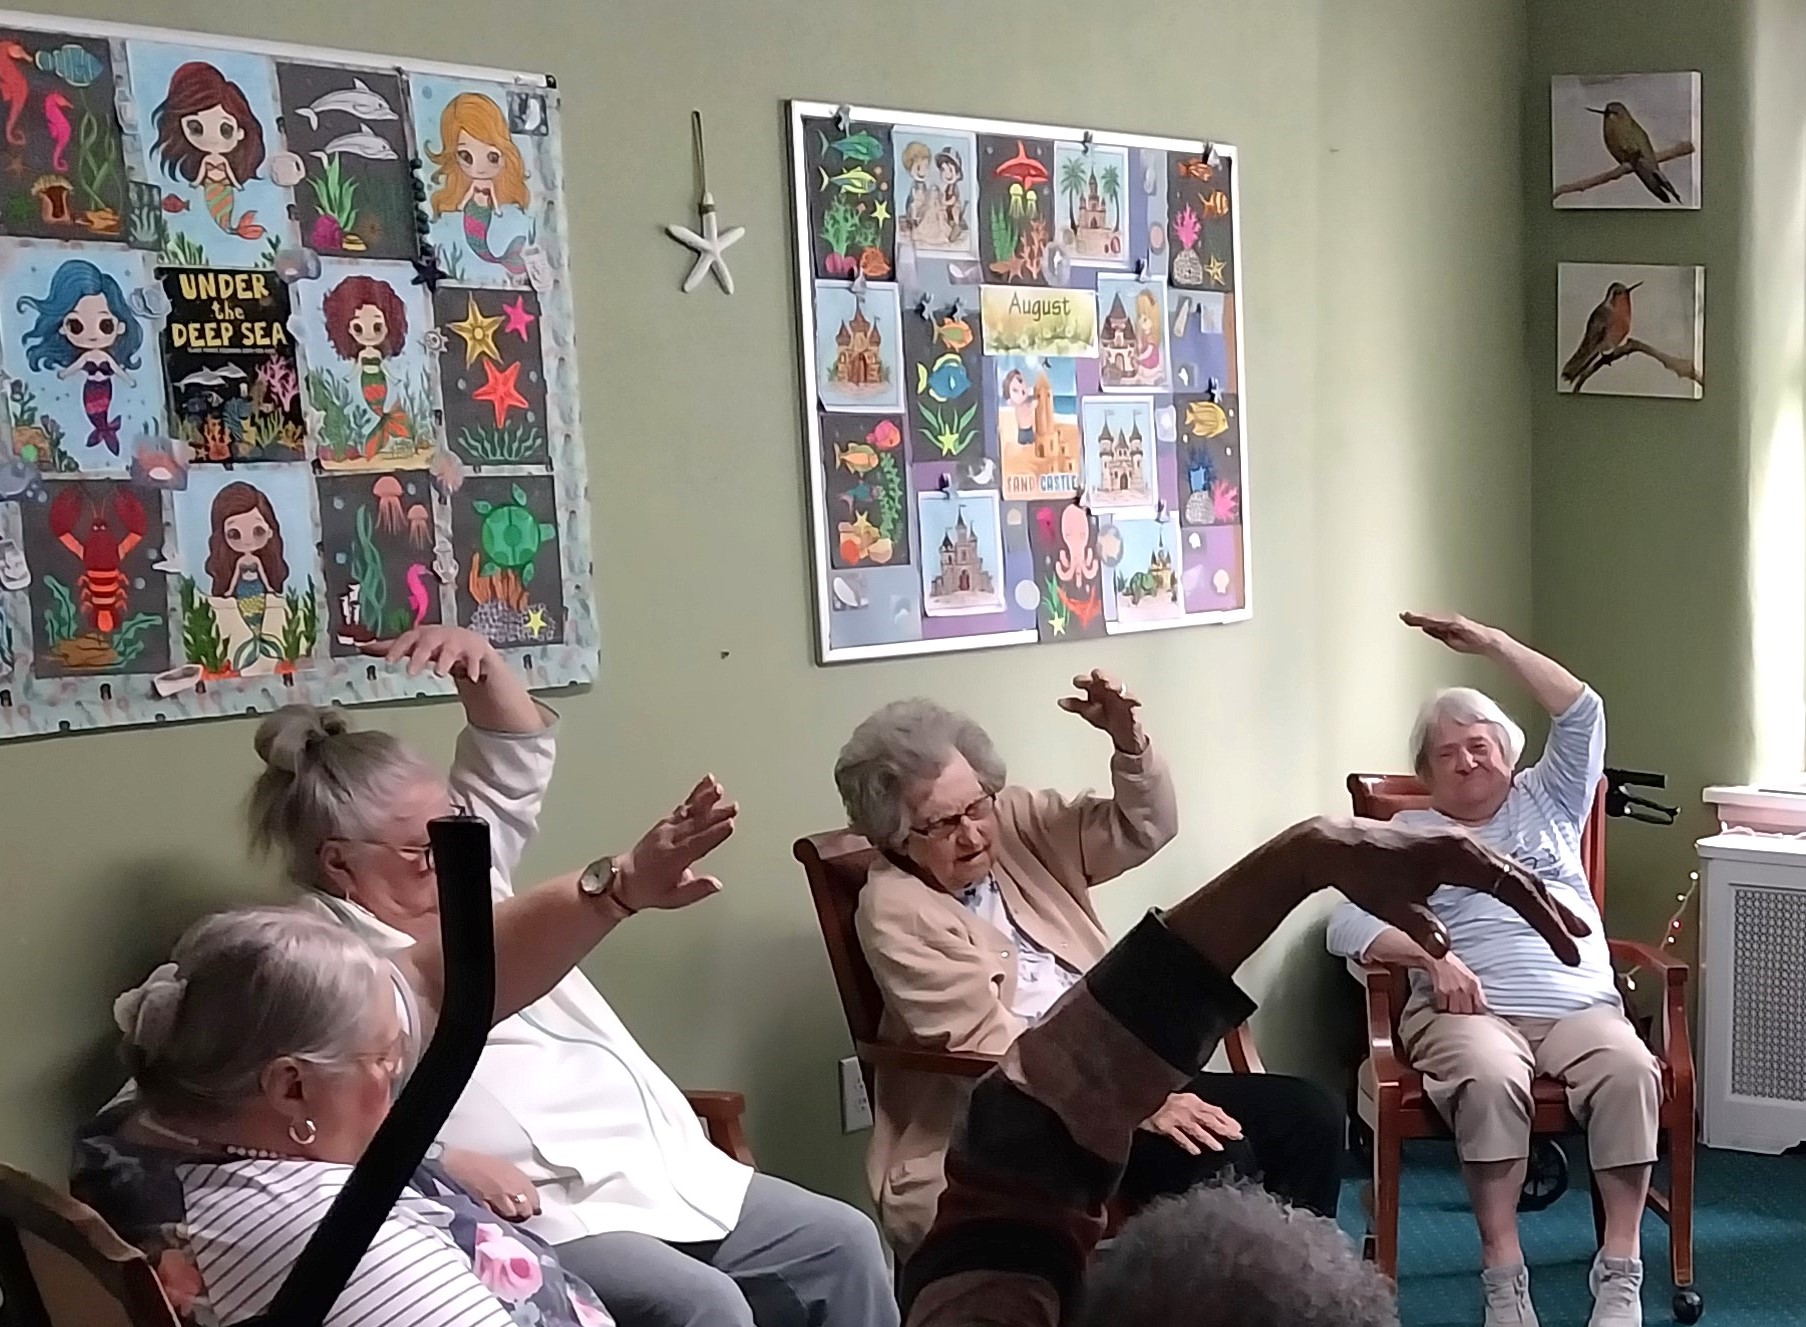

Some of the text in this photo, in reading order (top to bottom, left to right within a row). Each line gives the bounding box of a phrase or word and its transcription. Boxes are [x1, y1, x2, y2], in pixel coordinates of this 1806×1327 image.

[179, 272, 269, 300] UNDER
[211, 300, 245, 320] the
[1009, 291, 1071, 322] August
[171, 321, 288, 348] DEEP SEA
[1007, 475, 1078, 493] SAND CASTLE
